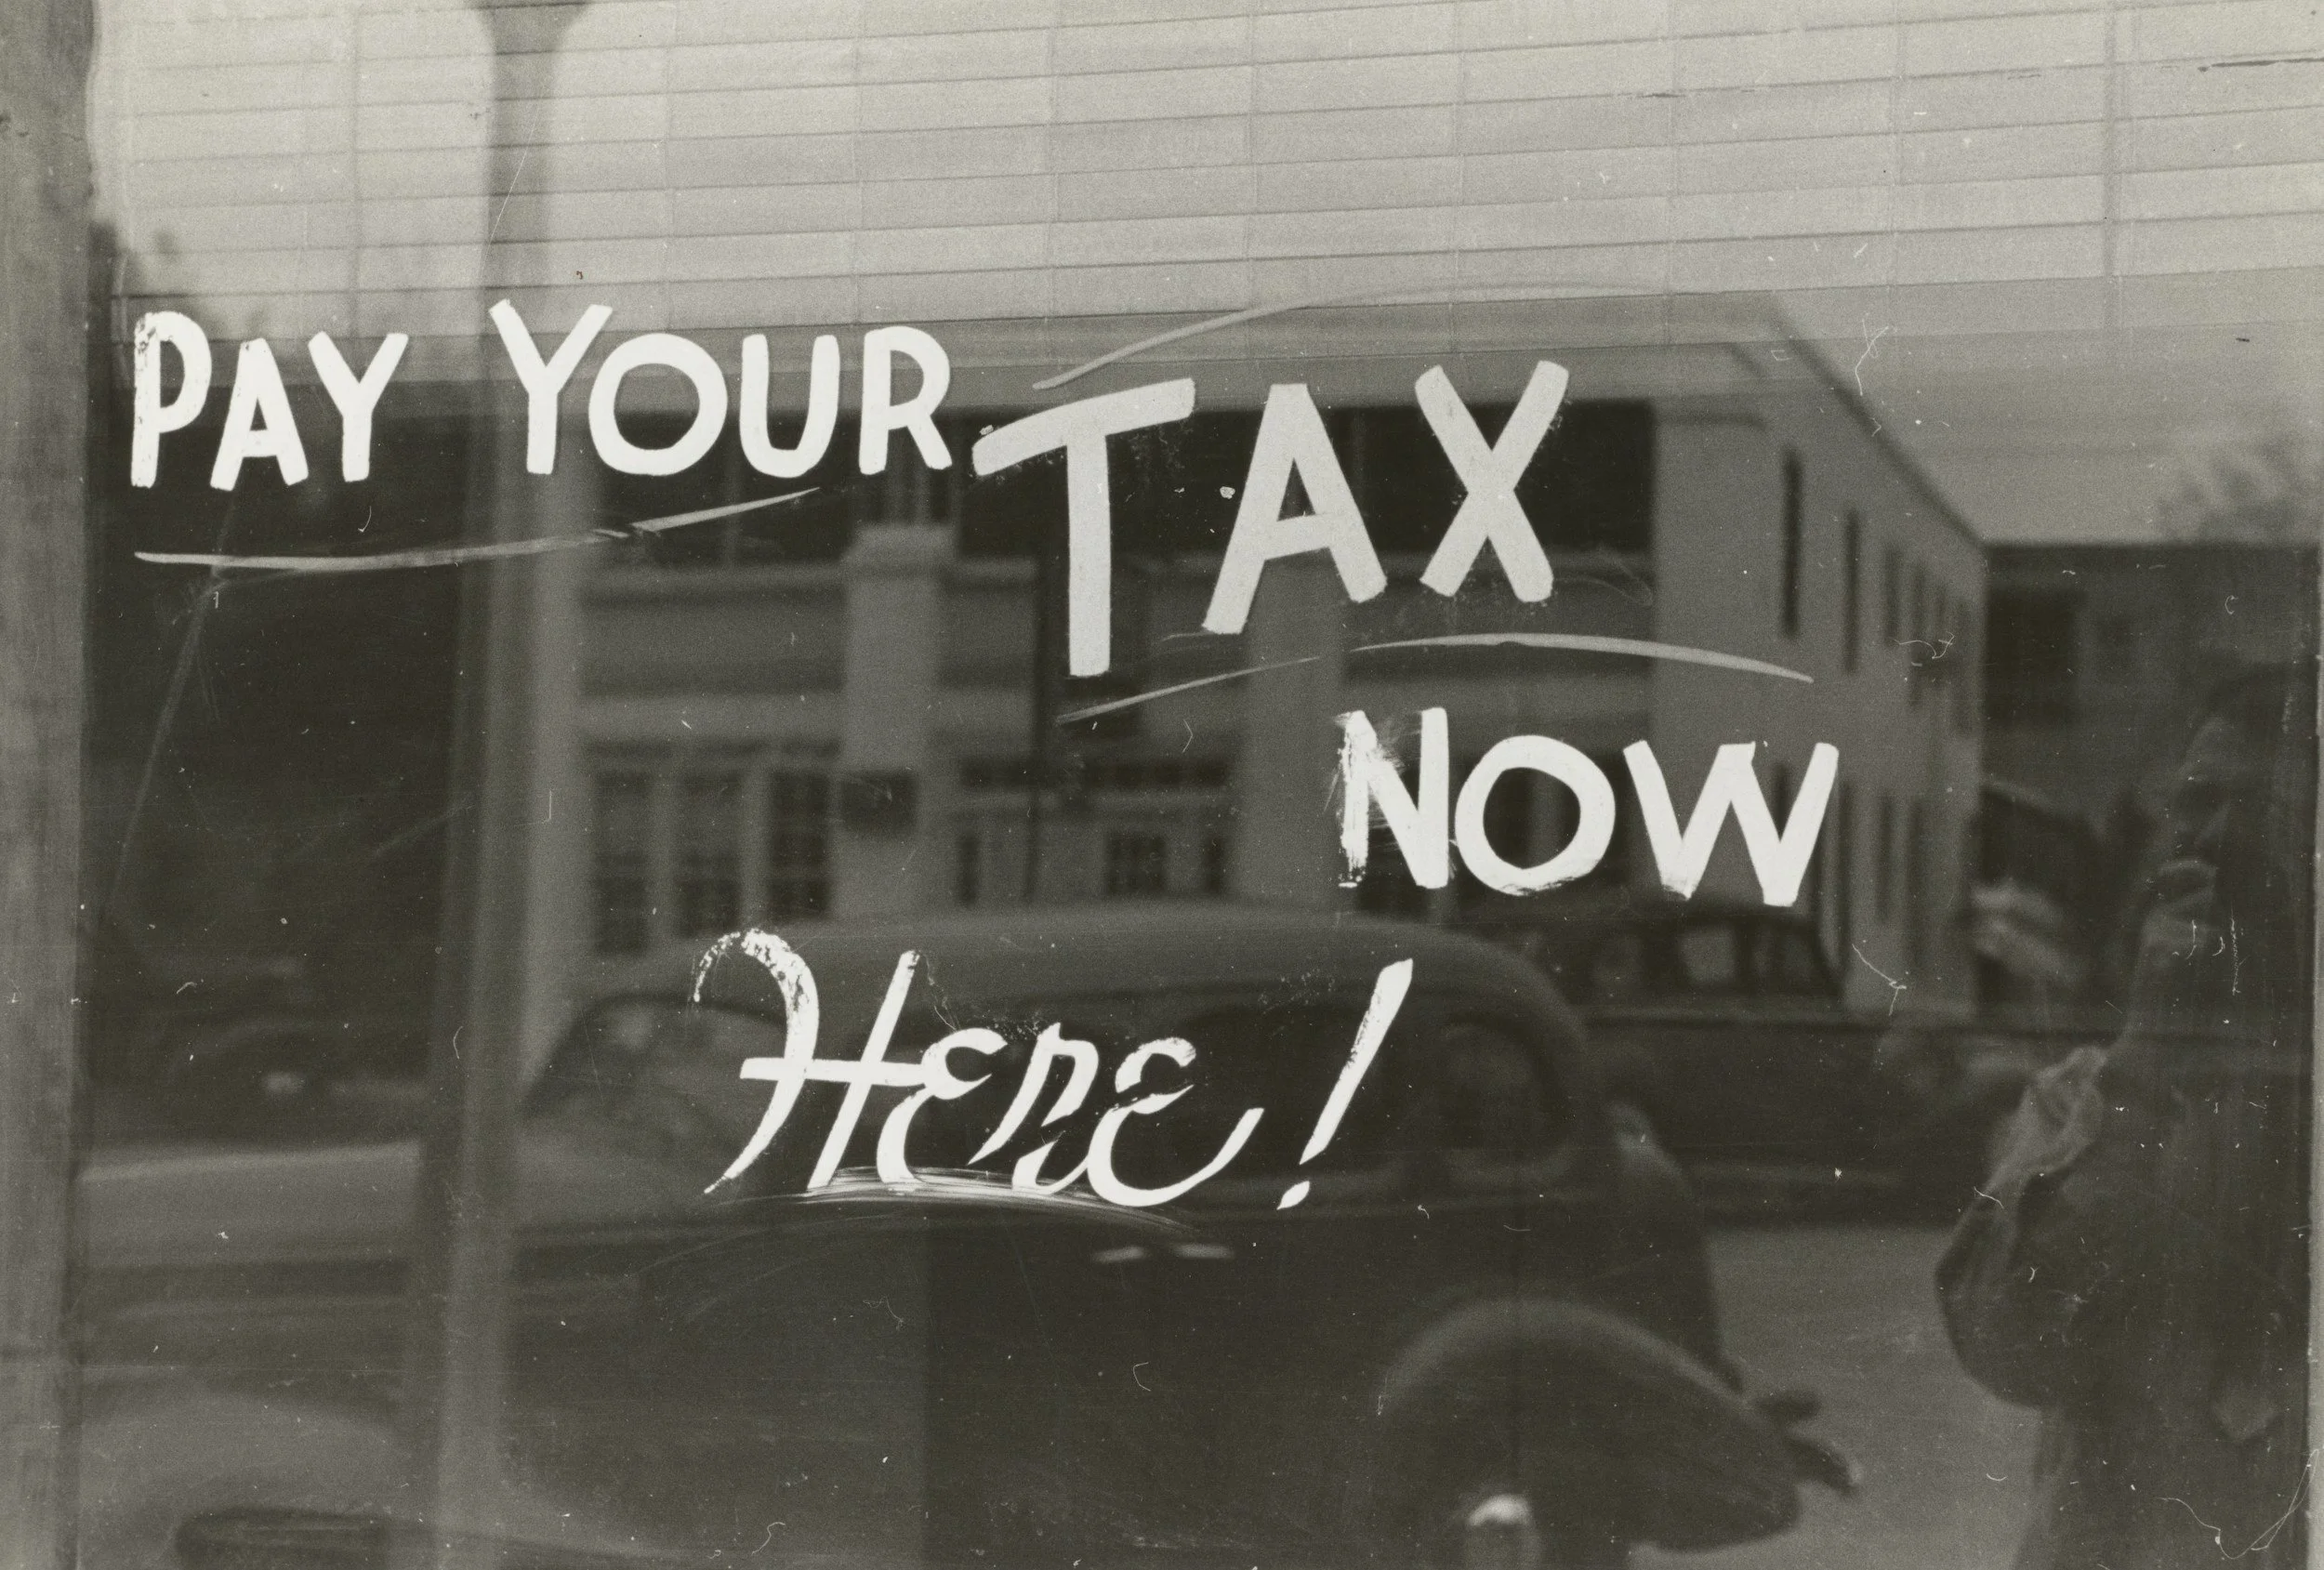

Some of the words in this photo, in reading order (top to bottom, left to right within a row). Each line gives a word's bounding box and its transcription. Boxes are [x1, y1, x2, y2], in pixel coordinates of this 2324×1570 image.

[130, 311, 409, 491] PAY
[489, 299, 952, 482] YOUR
[972, 360, 1569, 678] TAX
[1339, 706, 1839, 907] NOW
